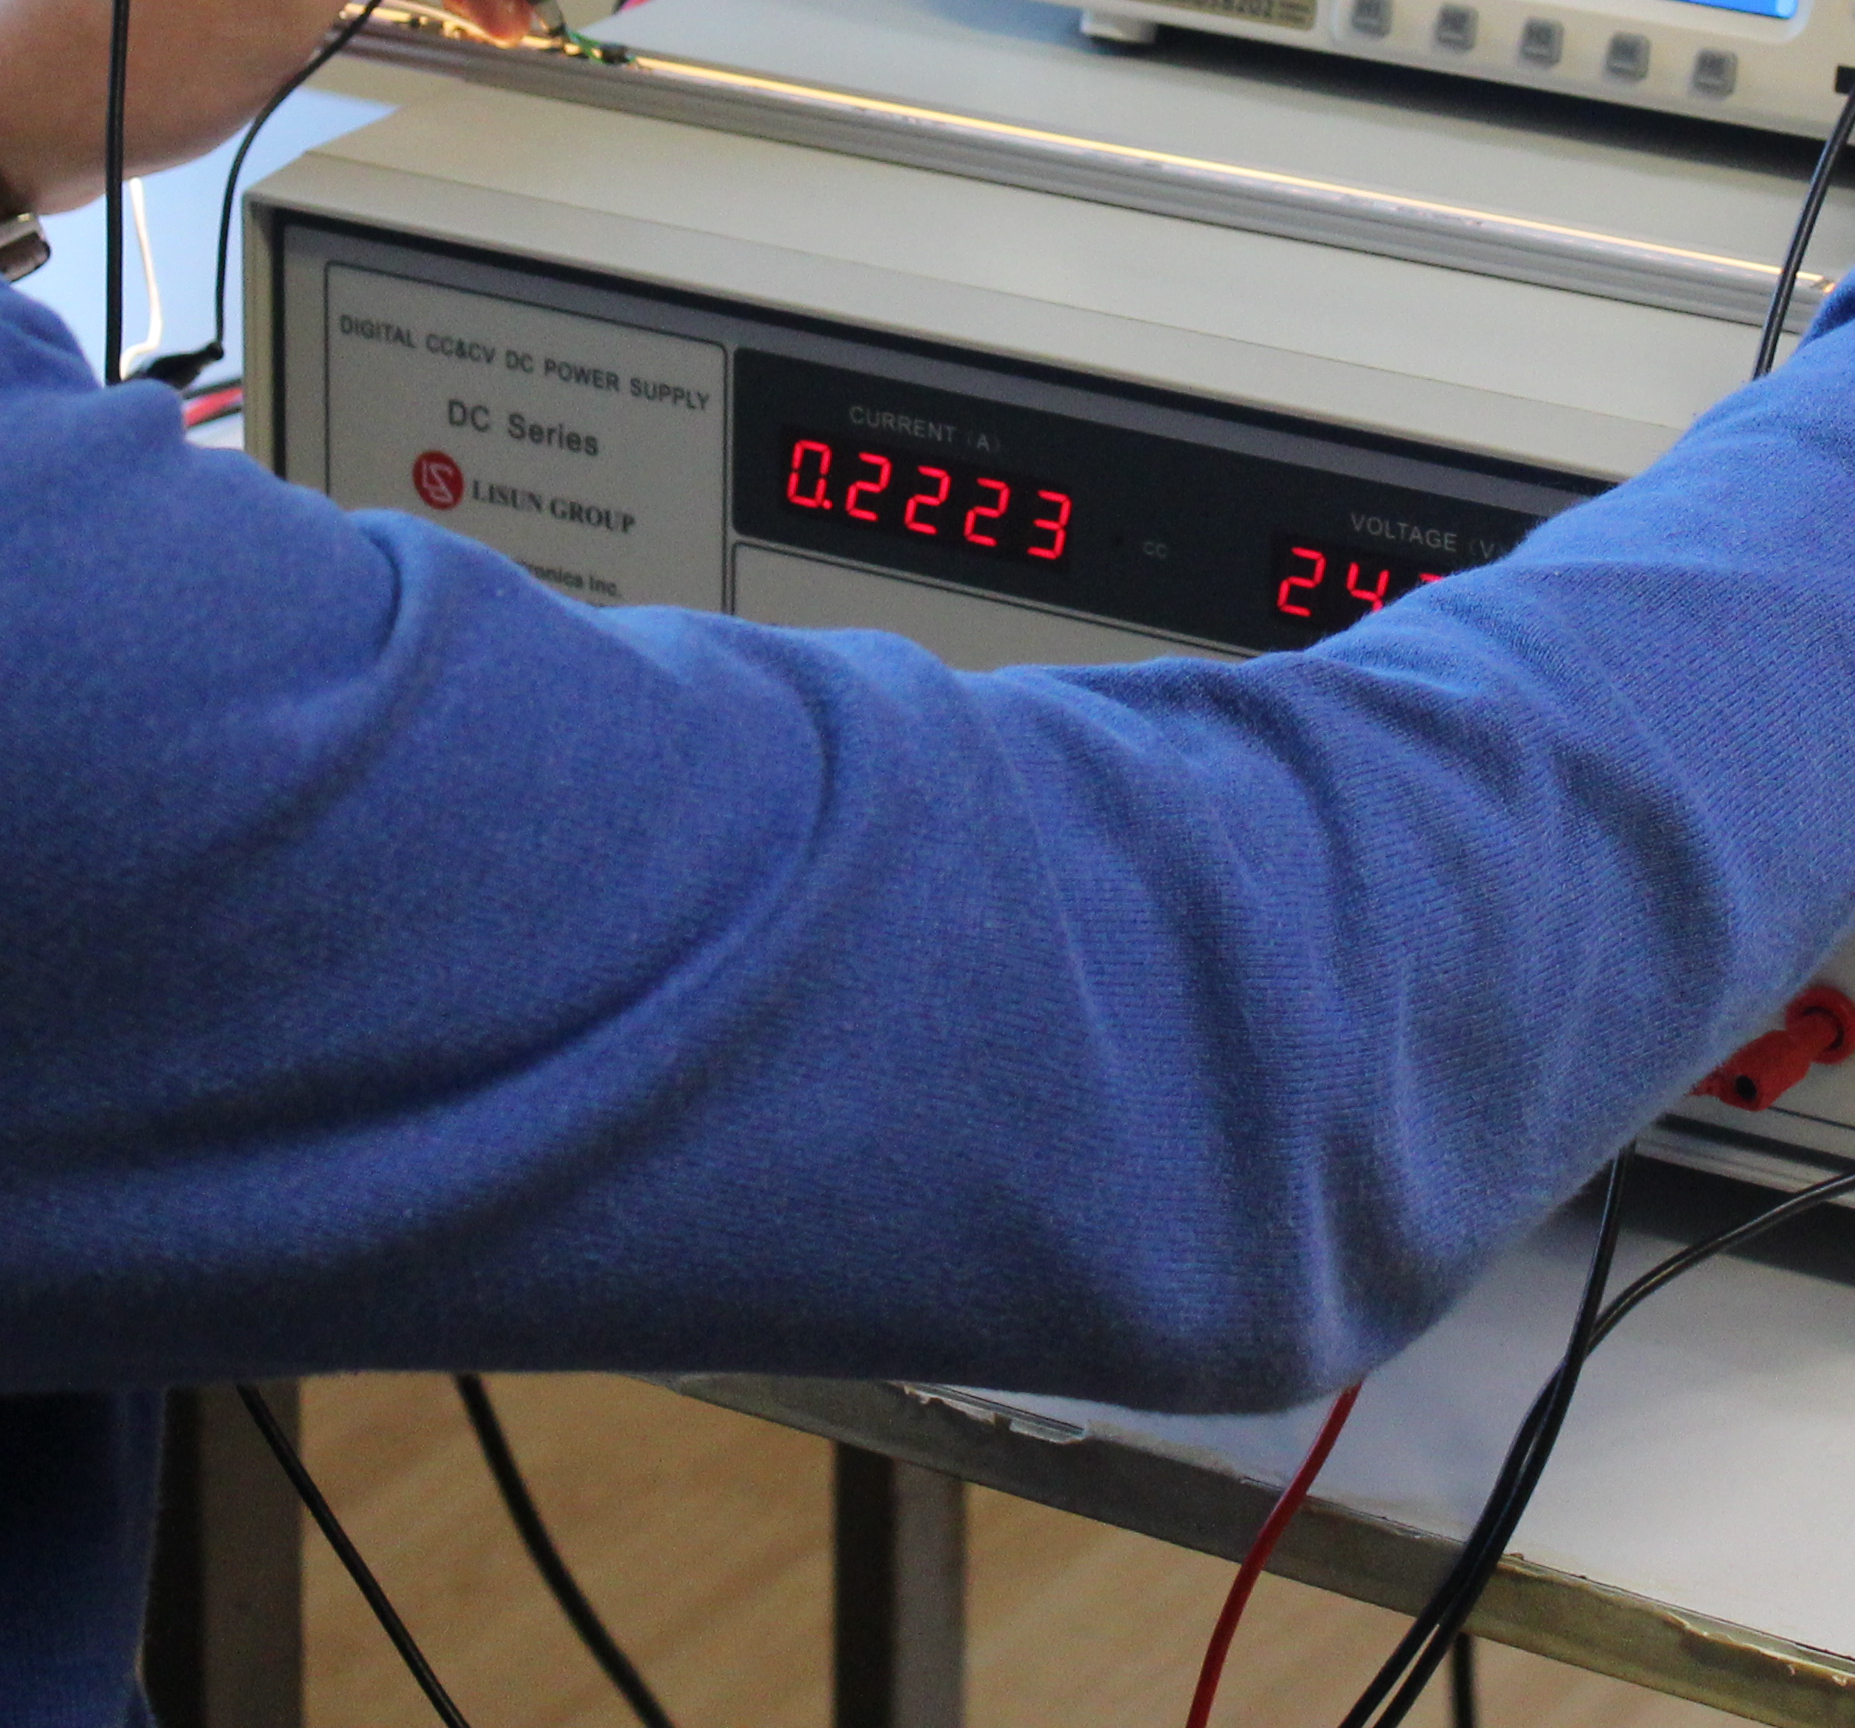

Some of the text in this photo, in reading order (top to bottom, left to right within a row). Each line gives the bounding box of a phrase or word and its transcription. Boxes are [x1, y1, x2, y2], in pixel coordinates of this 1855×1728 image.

[339, 314, 710, 411] DIGITAL CC&CV DC POWER SUPPLY
[447, 398, 599, 457] DC Series
[848, 404, 957, 444] CURRENT
[472, 479, 636, 534] LISUN GROUP
[786, 439, 1072, 560] 0.2223
[1143, 540, 1168, 560] CC
[1350, 512, 1458, 552] VOLTAGE
[1276, 546, 1444, 619] 24
